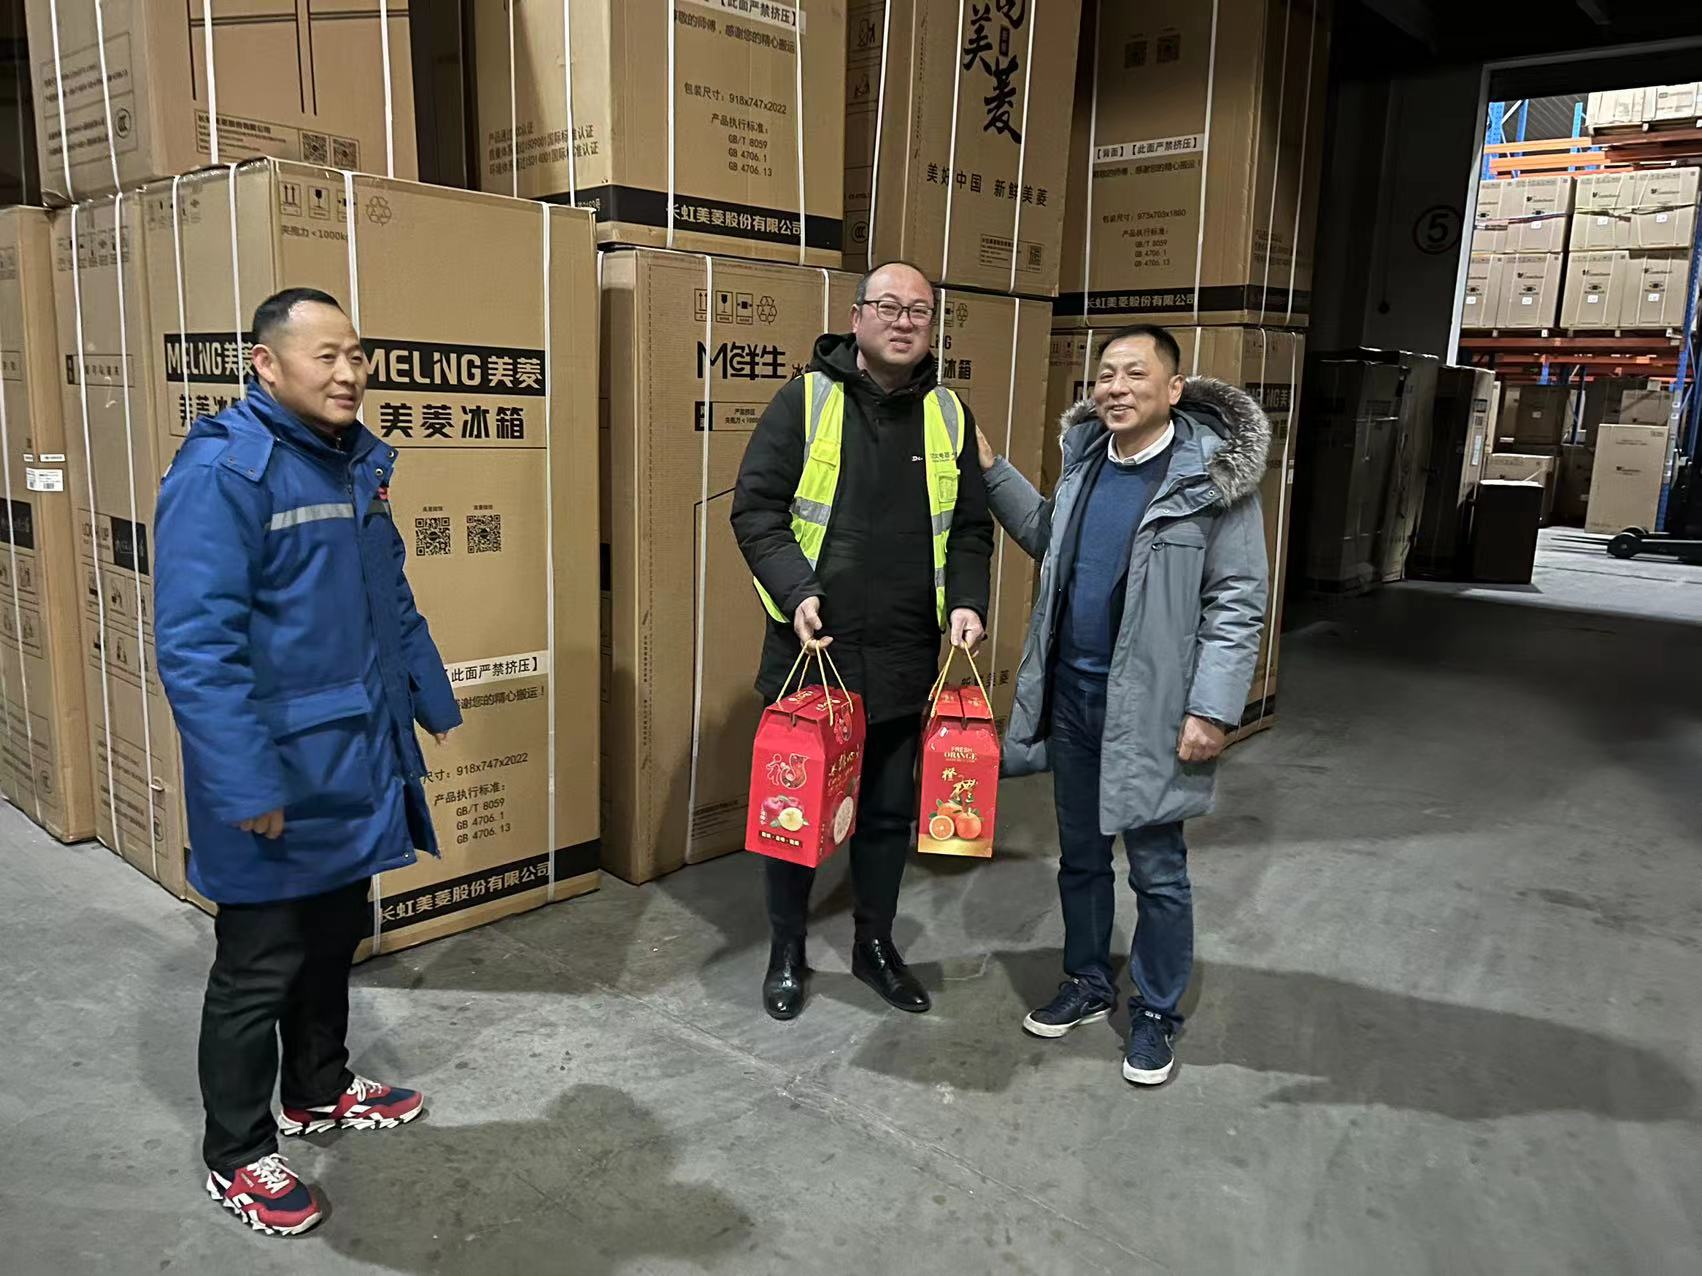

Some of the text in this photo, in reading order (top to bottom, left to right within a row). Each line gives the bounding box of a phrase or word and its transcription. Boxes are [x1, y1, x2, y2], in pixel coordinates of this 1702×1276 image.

[487, 356, 542, 389] 美菱
[380, 402, 525, 439] 美菱冰箱
[456, 686, 545, 710] 谢您的精心搬运！
[434, 782, 506, 806] 产品执行标准：
[456, 797, 505, 817] GB/T 8059
[457, 819, 469, 831] GB
[457, 833, 469, 845] GB
[380, 862, 550, 922] 长虹美菱股份有限公司
